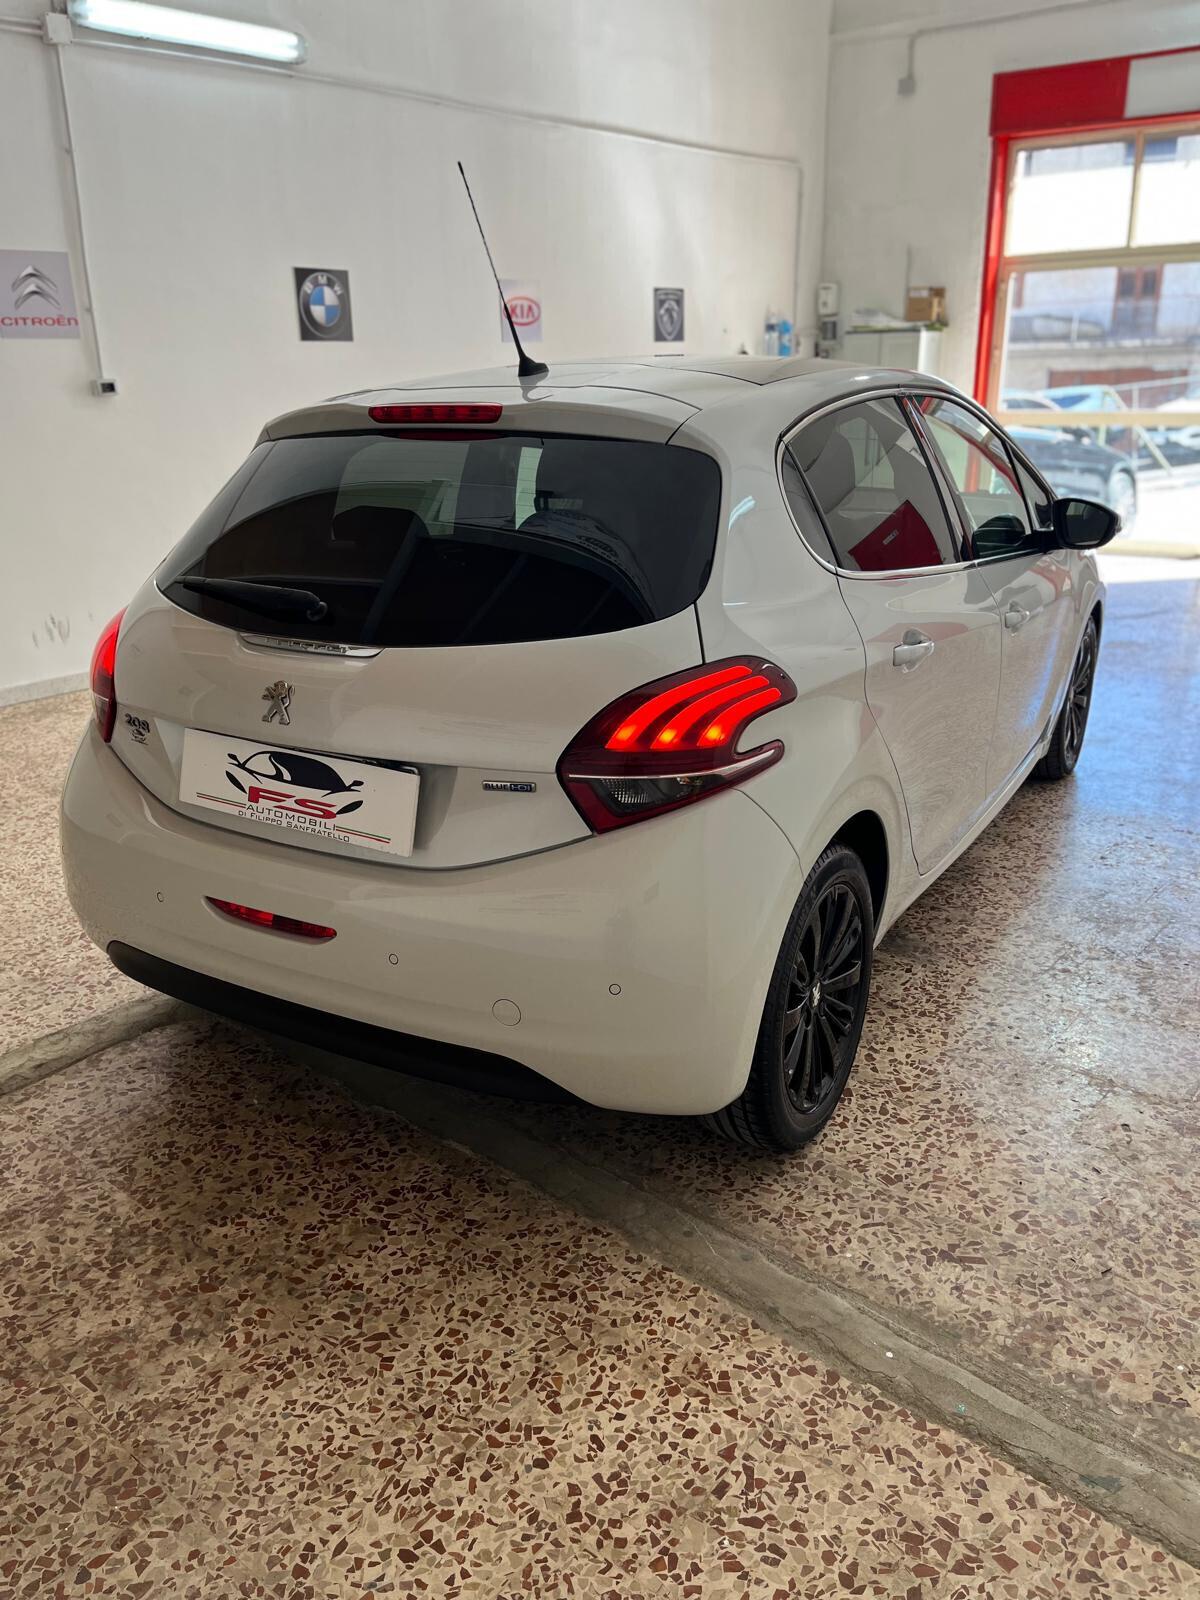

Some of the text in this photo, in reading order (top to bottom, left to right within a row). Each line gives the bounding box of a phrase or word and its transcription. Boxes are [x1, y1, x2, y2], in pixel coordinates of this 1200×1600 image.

[303, 274, 344, 296] BMW
[509, 303, 536, 320] KIA
[125, 712, 151, 734] 208
[484, 782, 510, 791] BLUE
[248, 785, 337, 819] FS
[246, 804, 336, 831] AUTOMOBILI
[286, 821, 350, 843] SANFRATELLO
